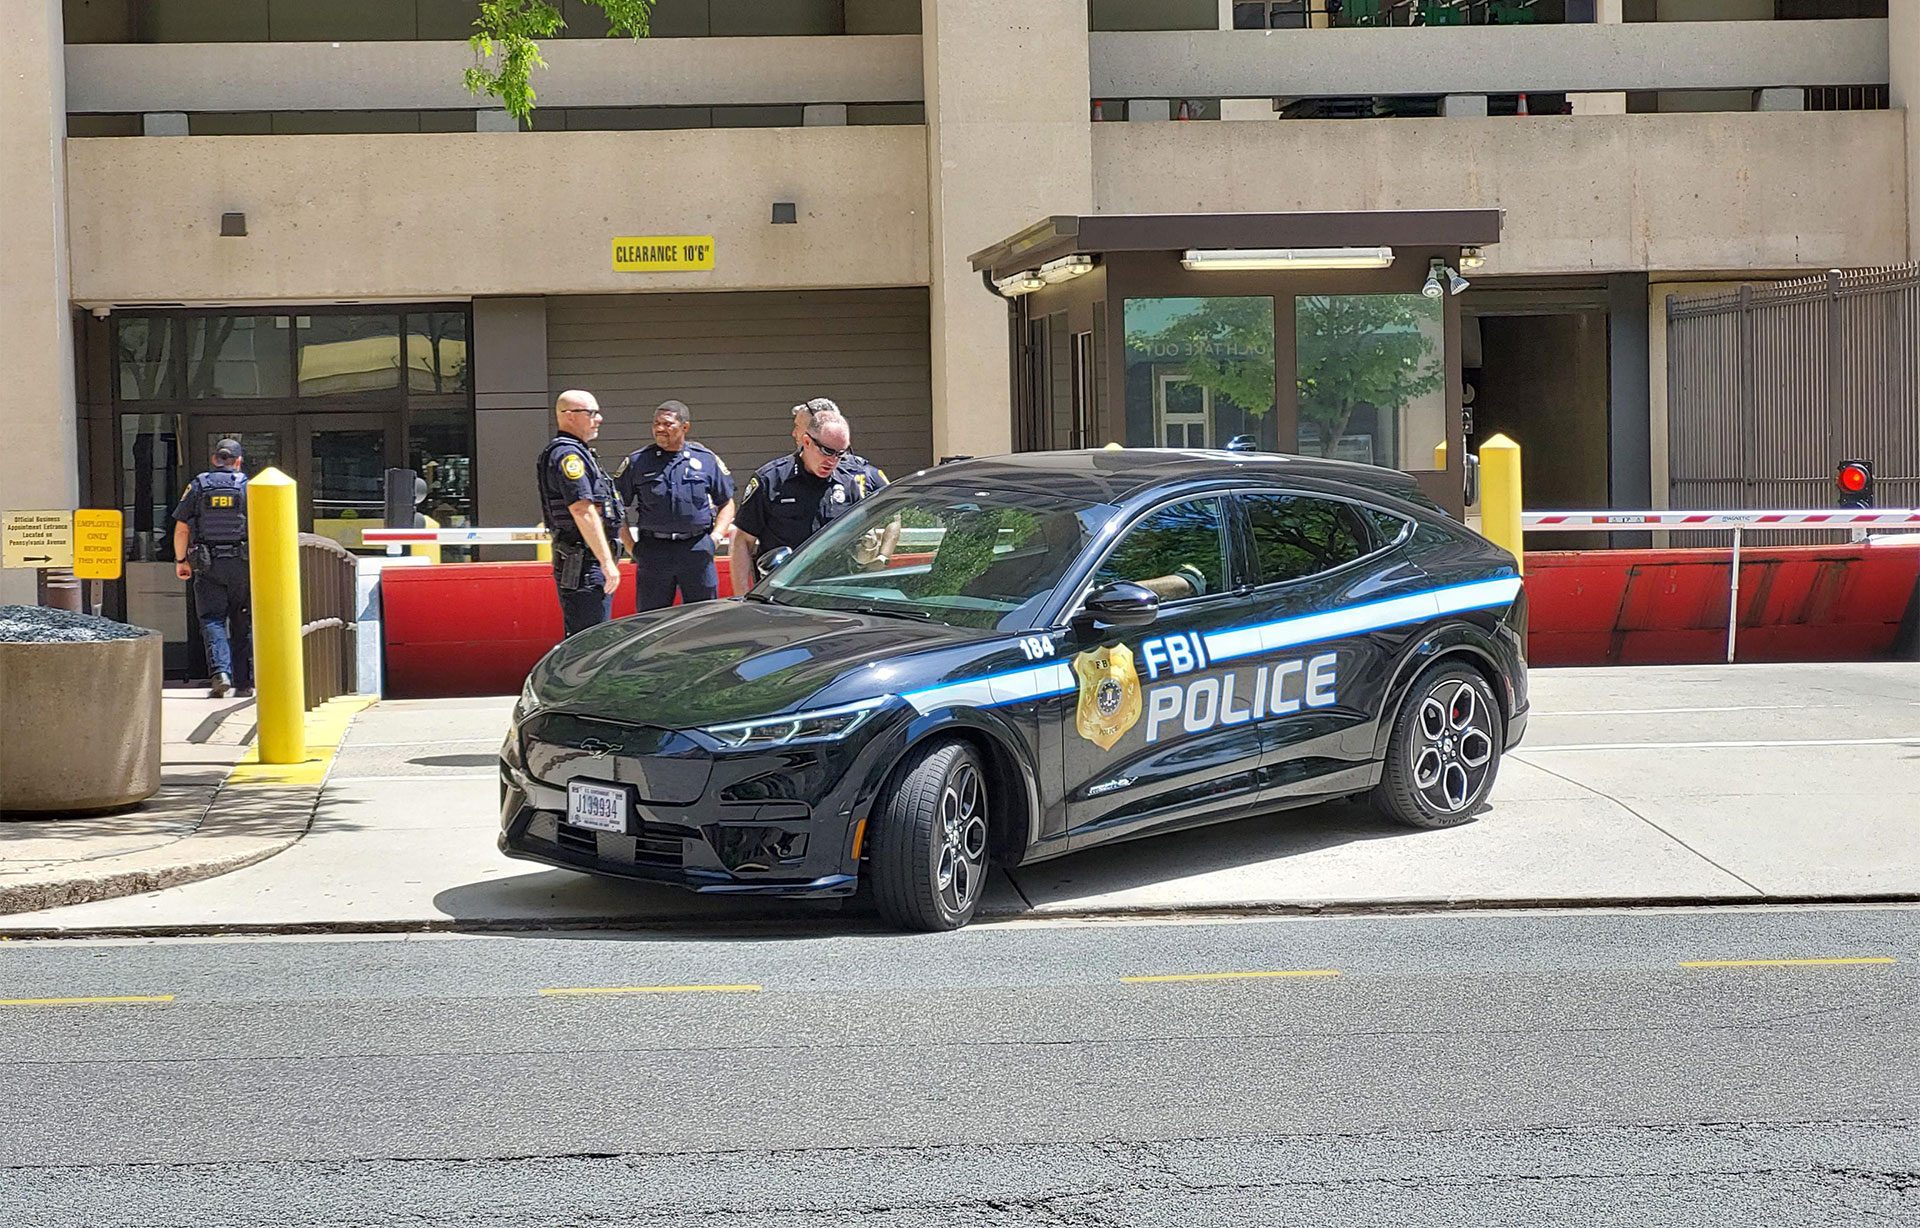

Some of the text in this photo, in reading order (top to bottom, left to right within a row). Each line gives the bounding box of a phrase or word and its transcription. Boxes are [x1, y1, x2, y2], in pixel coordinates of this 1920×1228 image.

[616, 244, 710, 262] CLEARANCE 10'6"
[211, 496, 233, 507] FBI
[1019, 635, 1055, 660] 184
[1143, 631, 1206, 680] FBI
[1145, 652, 1338, 743] POLICE
[1099, 725, 1118, 736] POLICE
